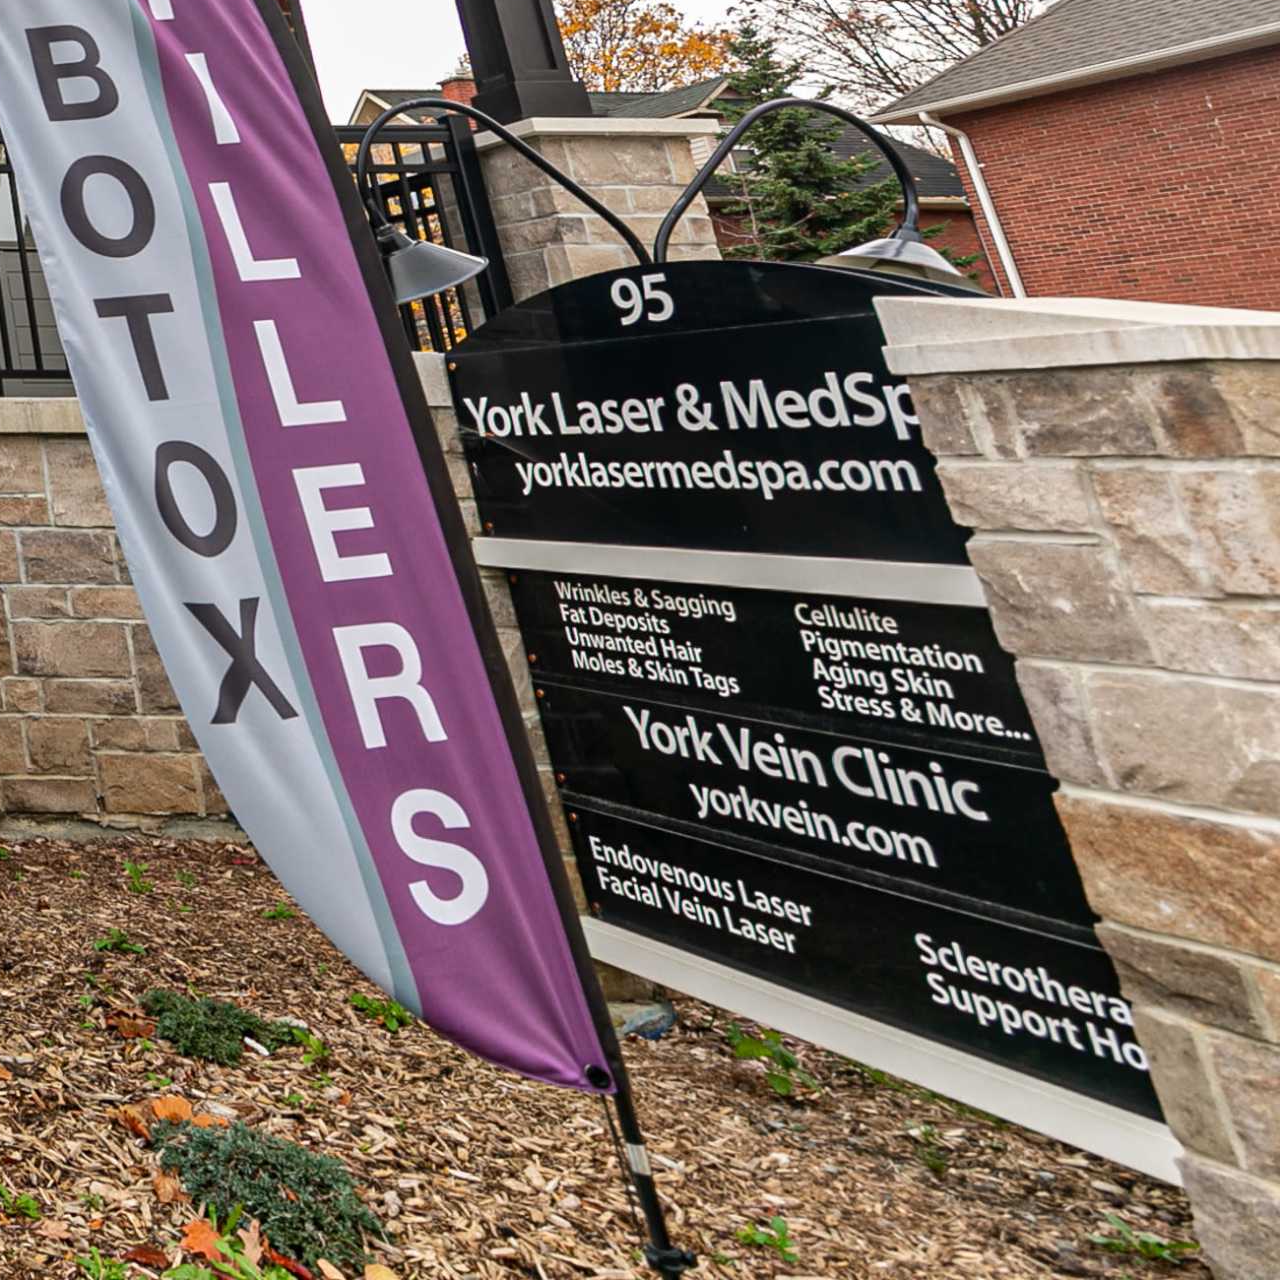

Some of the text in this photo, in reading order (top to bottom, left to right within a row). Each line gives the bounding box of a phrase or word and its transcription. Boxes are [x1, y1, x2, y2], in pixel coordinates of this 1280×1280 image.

[610, 272, 674, 327] 95
[25, 24, 299, 725] BOTOX
[462, 391, 553, 438] York
[551, 391, 666, 436] Laser
[676, 382, 719, 432] &
[515, 449, 923, 500] yorklasermedspa.com
[553, 580, 737, 622] Wrinkles & Sagging
[559, 603, 671, 634] Fat Deposits
[794, 602, 899, 634] Cellulite
[565, 626, 703, 663] Unwanted Hair
[799, 629, 984, 674] Pigmentation
[571, 648, 741, 697] Moles & Skin Tags
[813, 658, 955, 699] Aging Skin
[817, 685, 1032, 741] Stress & More...
[623, 705, 991, 821] York Vein Clinic
[689, 783, 939, 868] yorkvein.com
[589, 835, 812, 927] Endovenous Laser
[596, 866, 796, 954] Facial Vein Laser
[914, 932, 1134, 1026] Sclerothera
[926, 972, 1150, 1072] Support Ho
